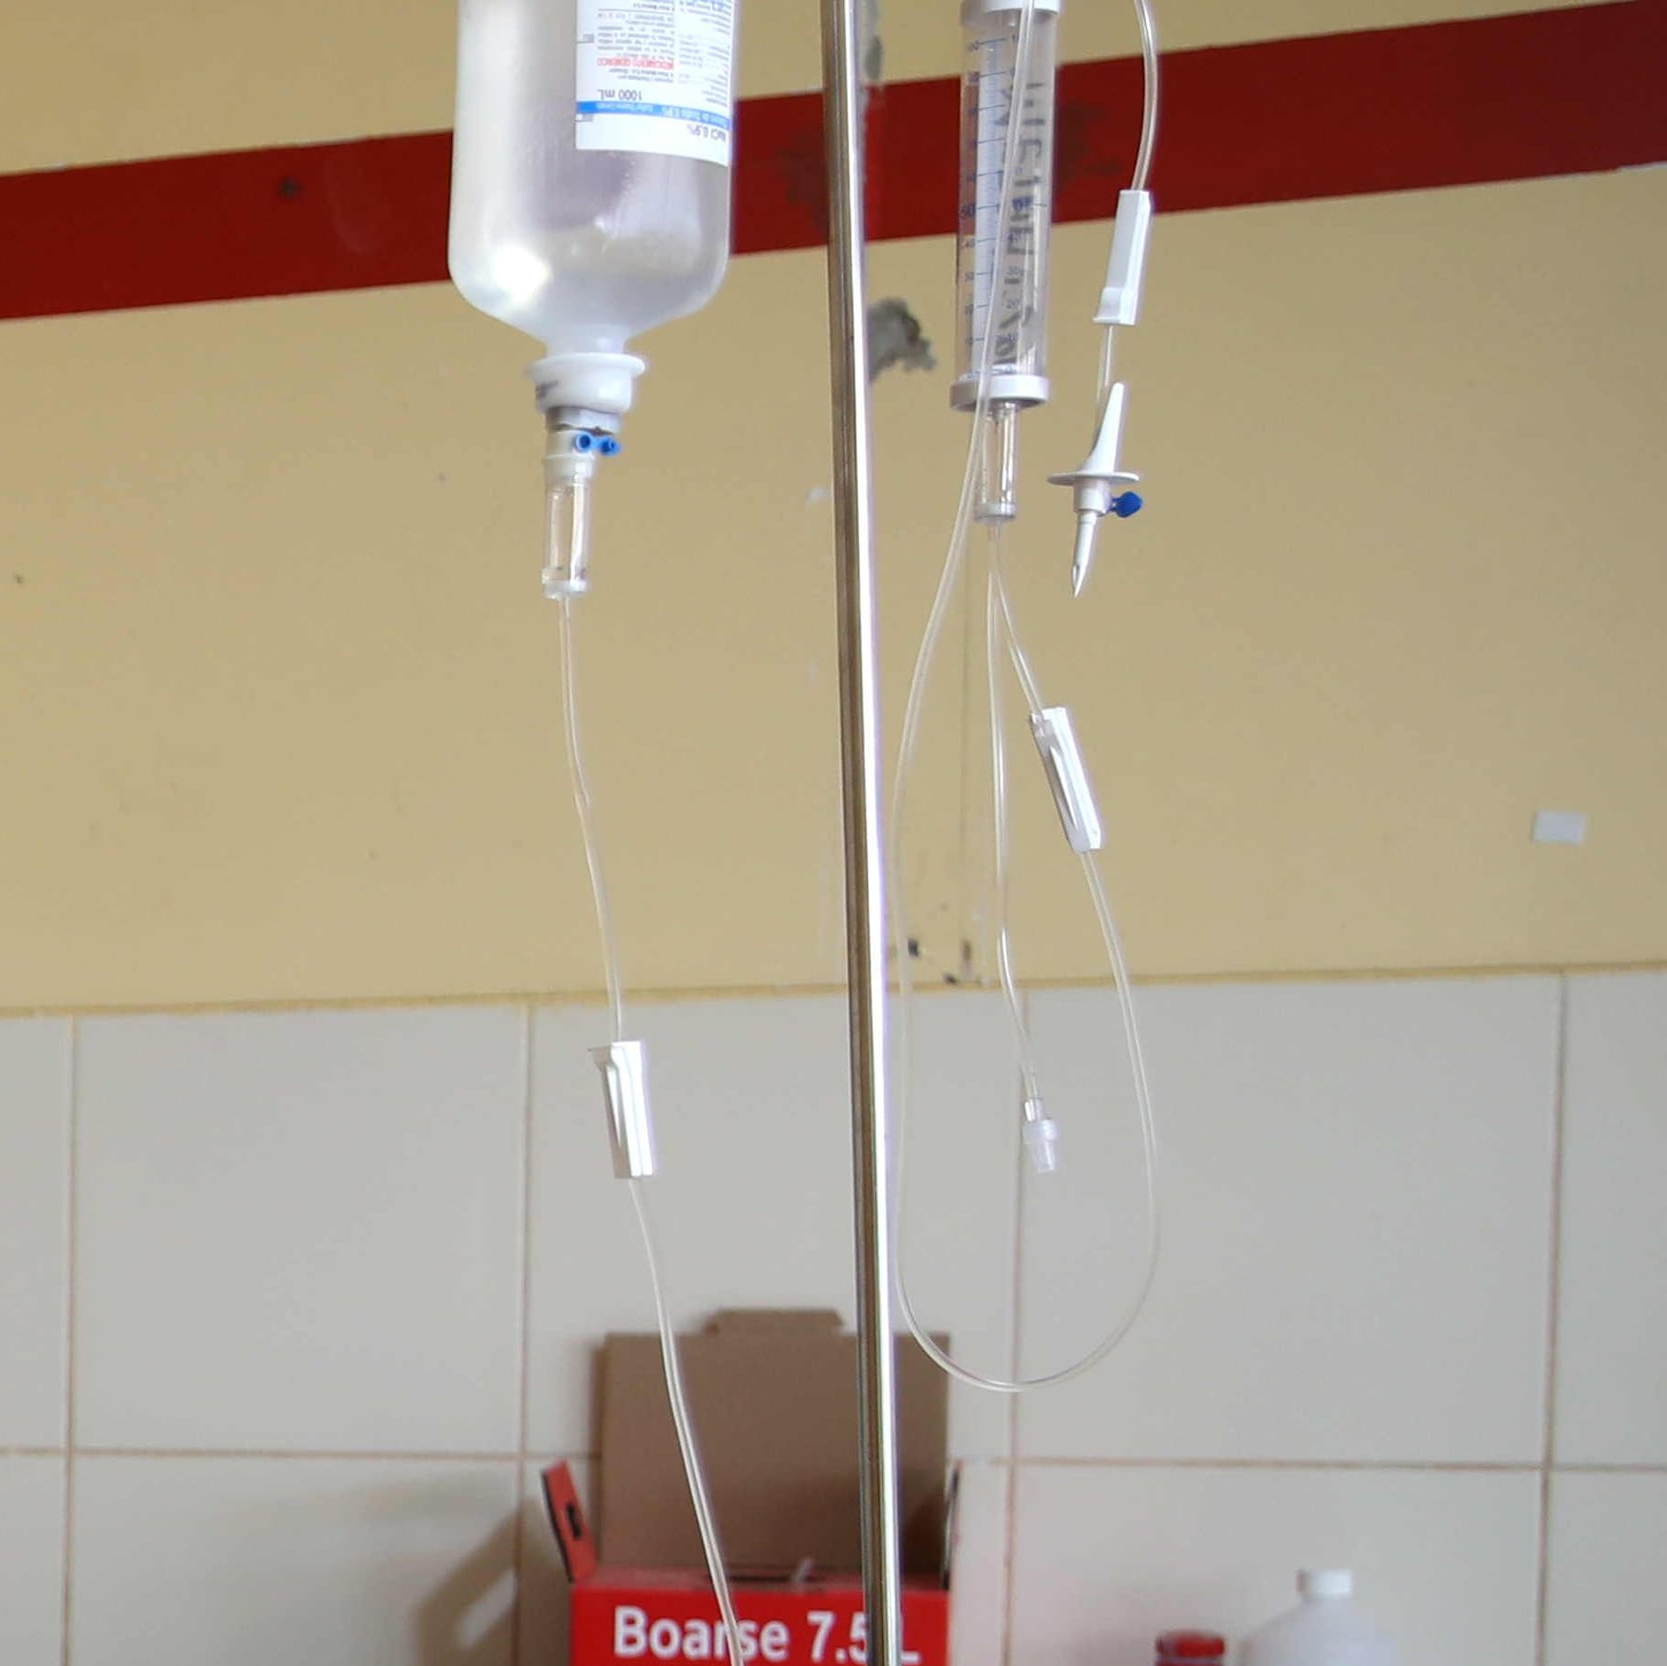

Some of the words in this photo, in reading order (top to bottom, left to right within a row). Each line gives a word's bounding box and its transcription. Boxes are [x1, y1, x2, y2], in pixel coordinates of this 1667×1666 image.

[596, 88, 616, 100] mL
[618, 89, 642, 101] 1000
[613, 1604, 791, 1664] Boarse
